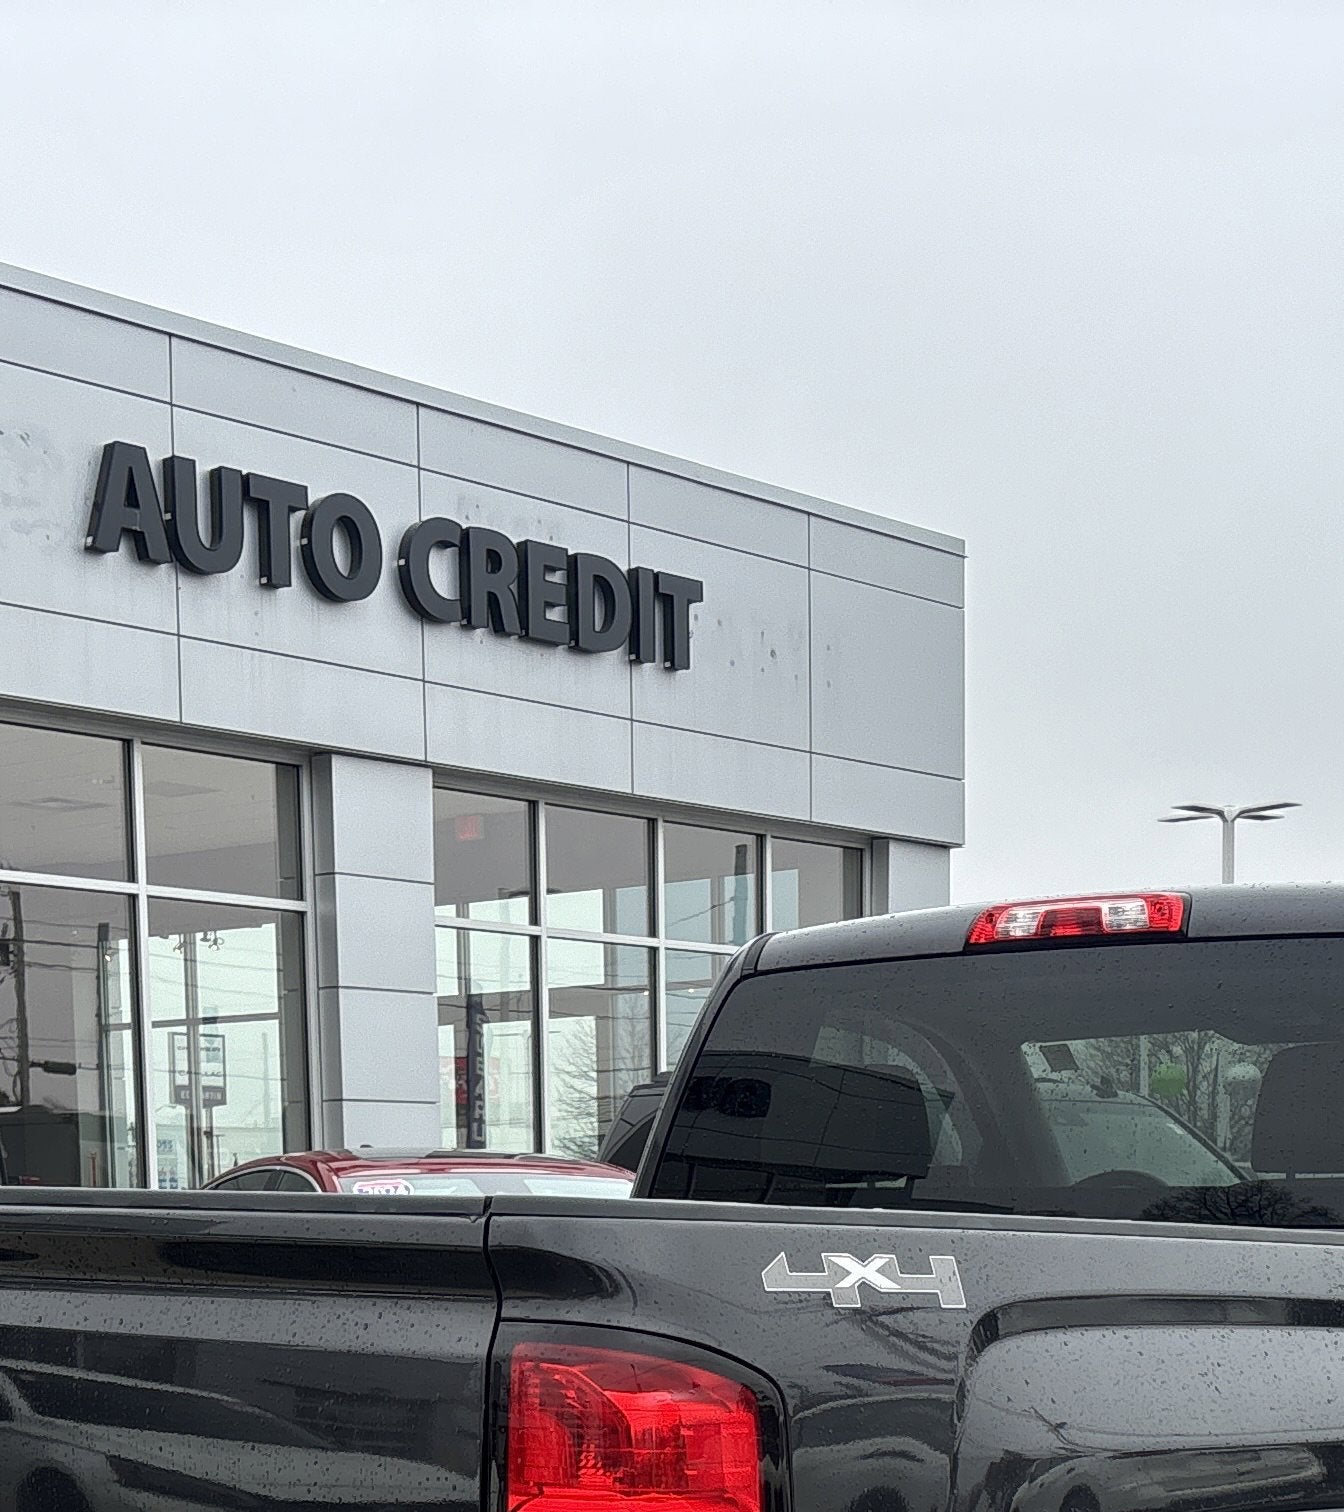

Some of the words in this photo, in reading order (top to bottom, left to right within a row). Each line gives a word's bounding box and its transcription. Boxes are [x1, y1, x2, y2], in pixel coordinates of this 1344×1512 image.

[84, 440, 383, 602] AUTO
[398, 516, 704, 671] CREDIT
[761, 1251, 967, 1309] 4X4
